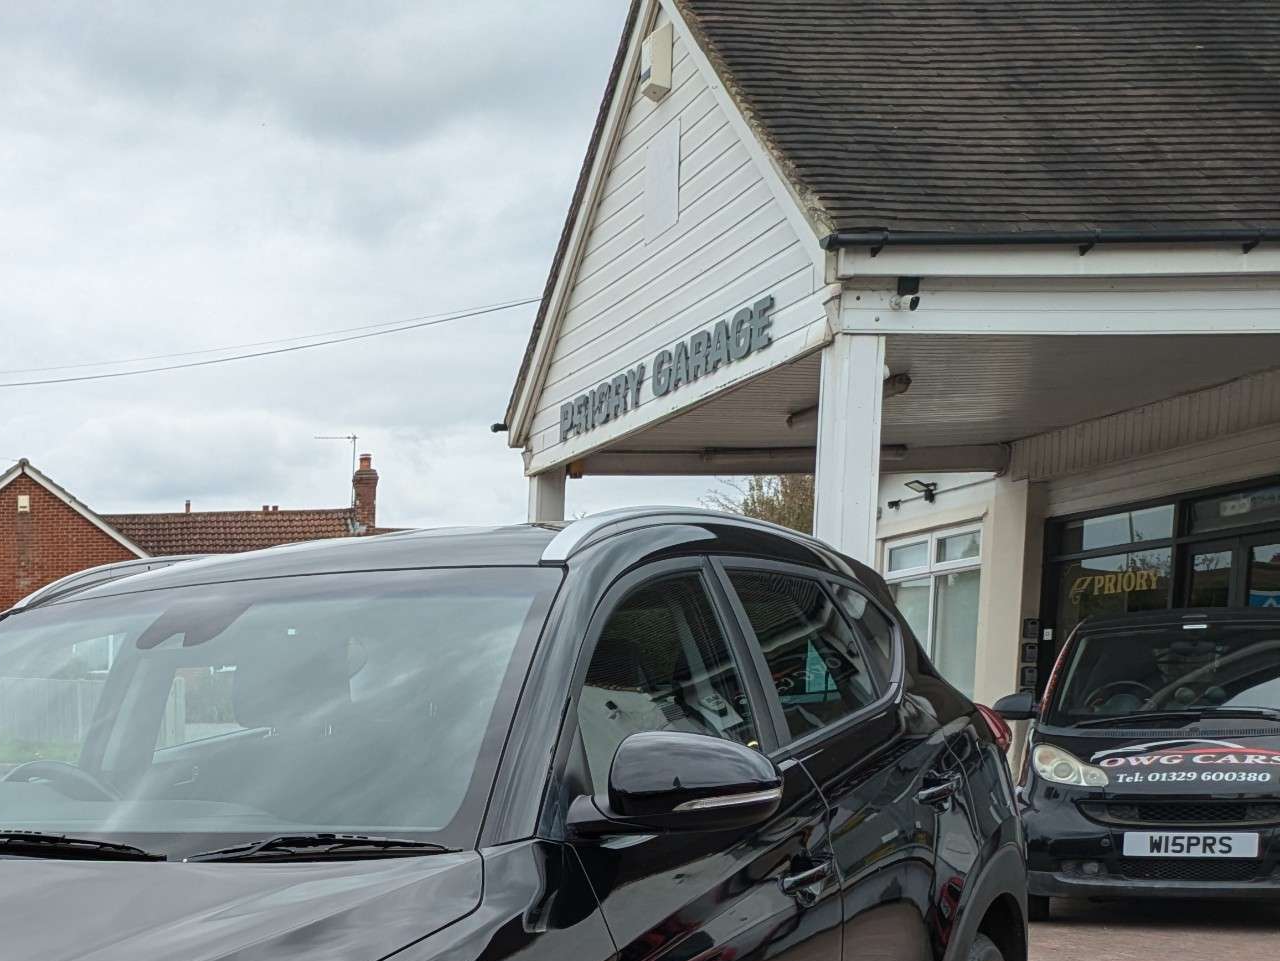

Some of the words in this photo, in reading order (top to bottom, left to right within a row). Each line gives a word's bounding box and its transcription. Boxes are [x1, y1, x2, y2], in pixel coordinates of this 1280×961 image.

[560, 363, 645, 441] PRIORY
[652, 294, 775, 397] GARAGE
[1093, 569, 1158, 595] PRIORY
[1099, 753, 1183, 767] OWG
[1192, 754, 1280, 765] CARS
[1116, 772, 1144, 783] Tel:
[1147, 771, 1198, 783] 01329
[1200, 771, 1271, 783] 600380
